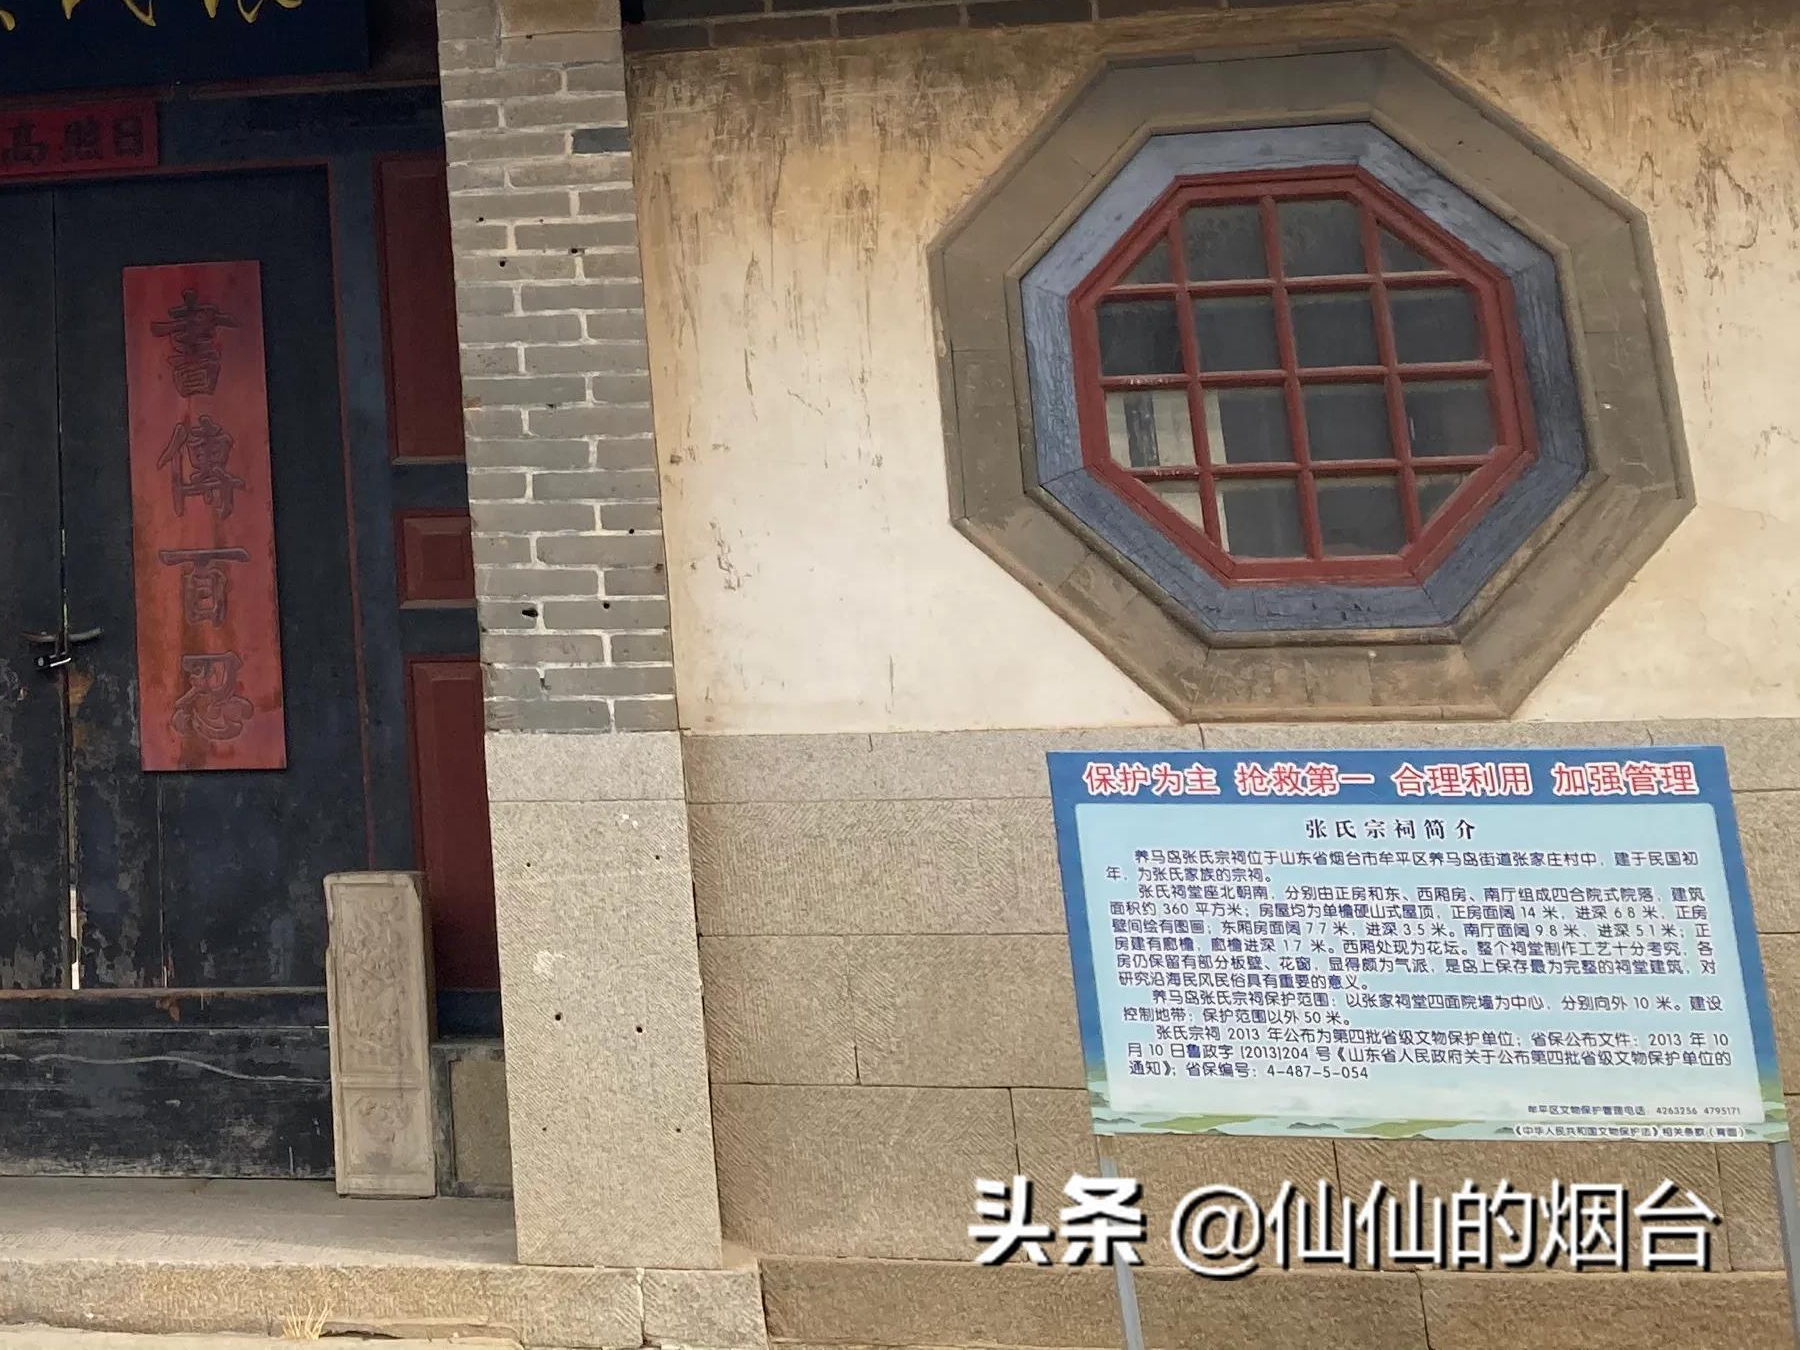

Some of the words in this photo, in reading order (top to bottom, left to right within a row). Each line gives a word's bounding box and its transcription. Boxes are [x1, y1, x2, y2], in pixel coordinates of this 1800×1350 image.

[1084, 763, 1220, 795] 保护为主
[1236, 763, 1375, 795] 抢救第一
[1392, 763, 1533, 795] 合理利用
[1551, 763, 1699, 795] 加强管理
[1305, 818, 1476, 840] 张氏宗祠简介
[1105, 867, 1271, 884] 年，为张氏家族的宗祠。
[1162, 902, 1189, 916] 360
[1632, 996, 1648, 1010] 10
[1226, 1027, 1260, 1041] 2013
